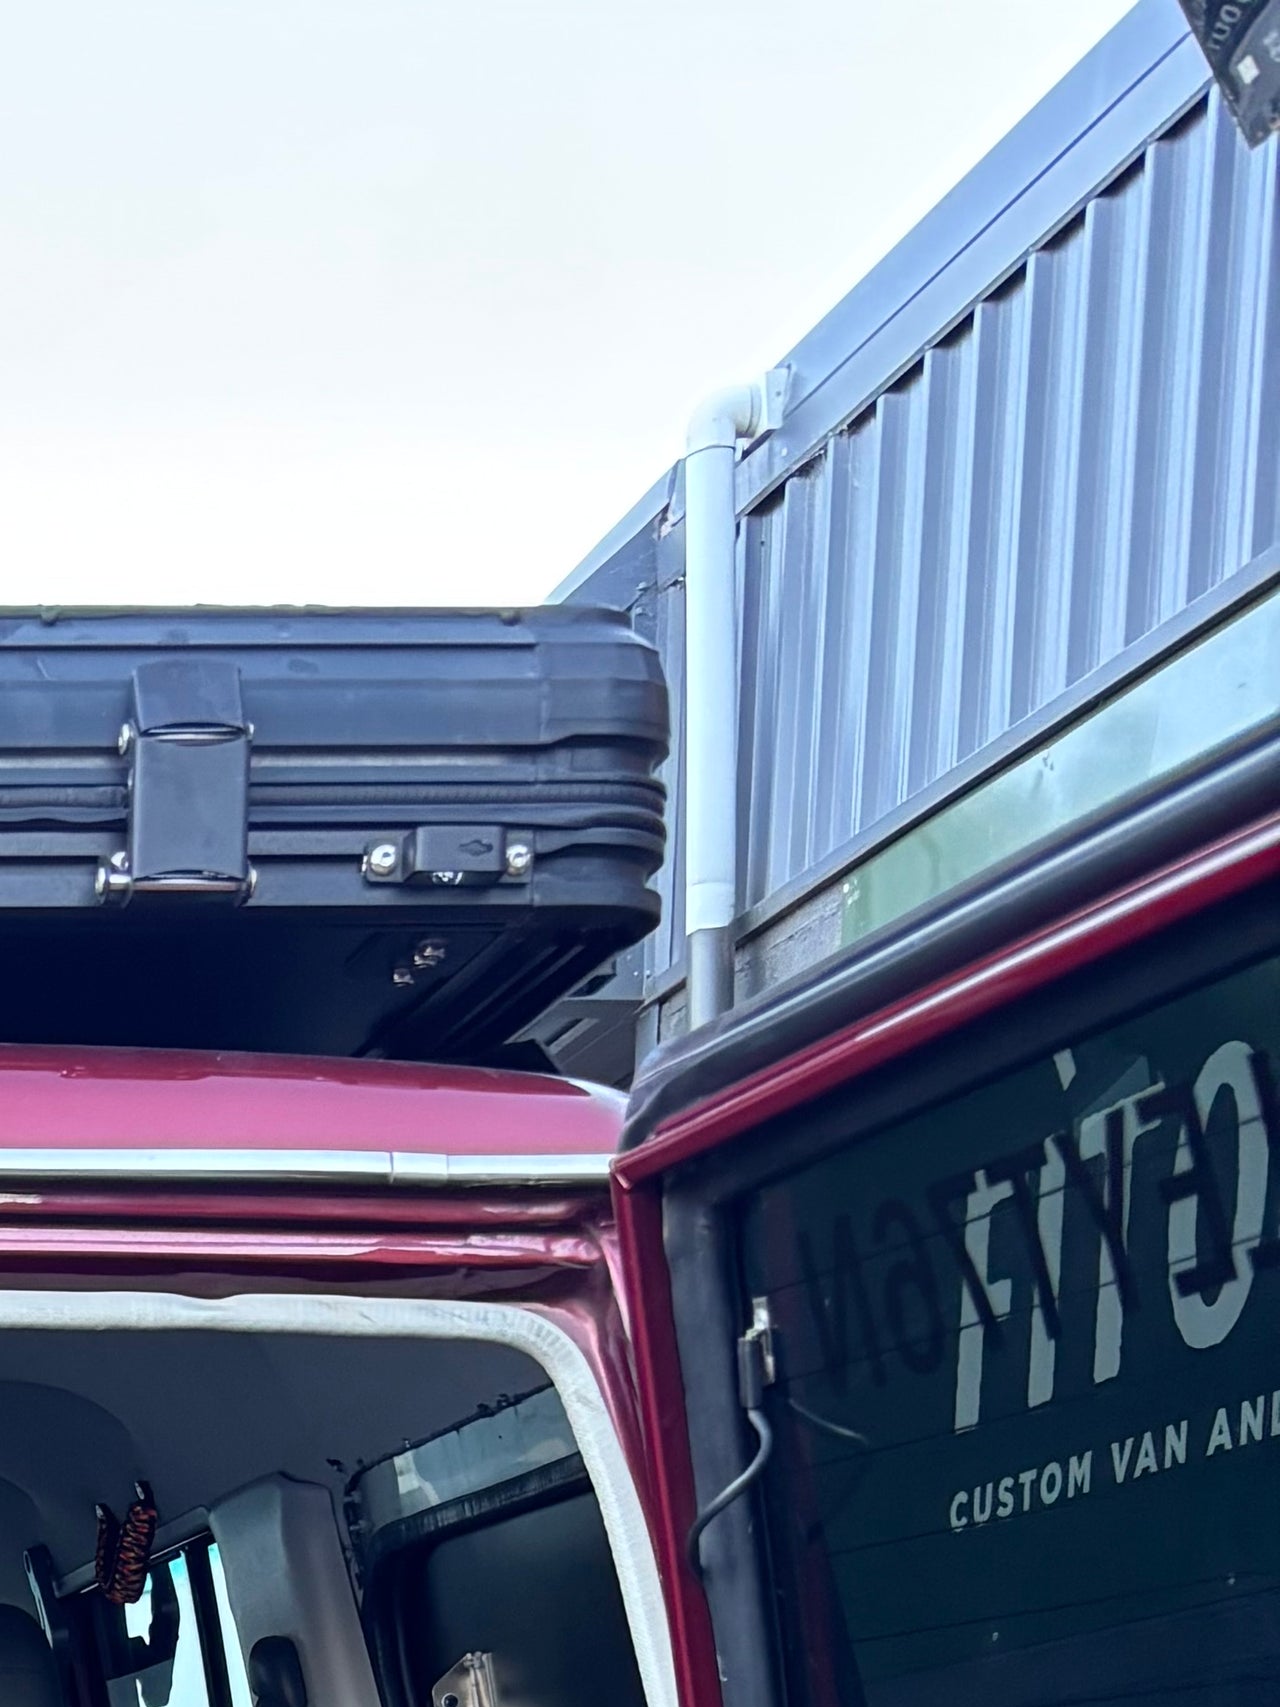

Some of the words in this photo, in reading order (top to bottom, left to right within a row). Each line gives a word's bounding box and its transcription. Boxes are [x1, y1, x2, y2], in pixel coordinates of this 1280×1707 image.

[954, 1040, 1280, 1434] FITO
[949, 1450, 1092, 1532] CUSTOM
[1111, 1419, 1189, 1484] VAN
